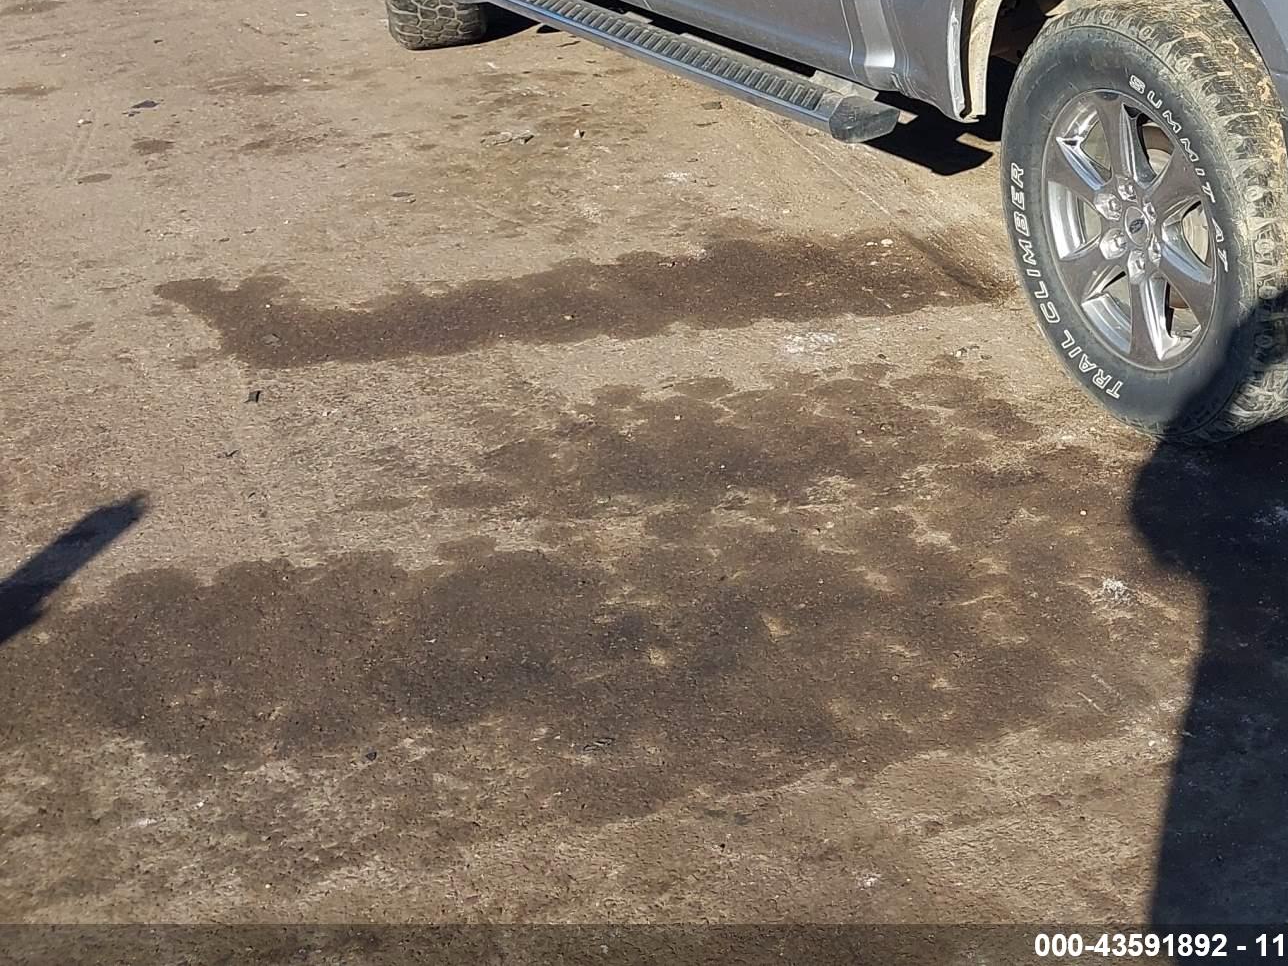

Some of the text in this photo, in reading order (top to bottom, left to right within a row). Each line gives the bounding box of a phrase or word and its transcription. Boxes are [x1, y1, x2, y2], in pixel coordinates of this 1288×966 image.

[1129, 74, 1216, 204] SUMMIT
[1010, 162, 1124, 400] TRAIL CLIMBER
